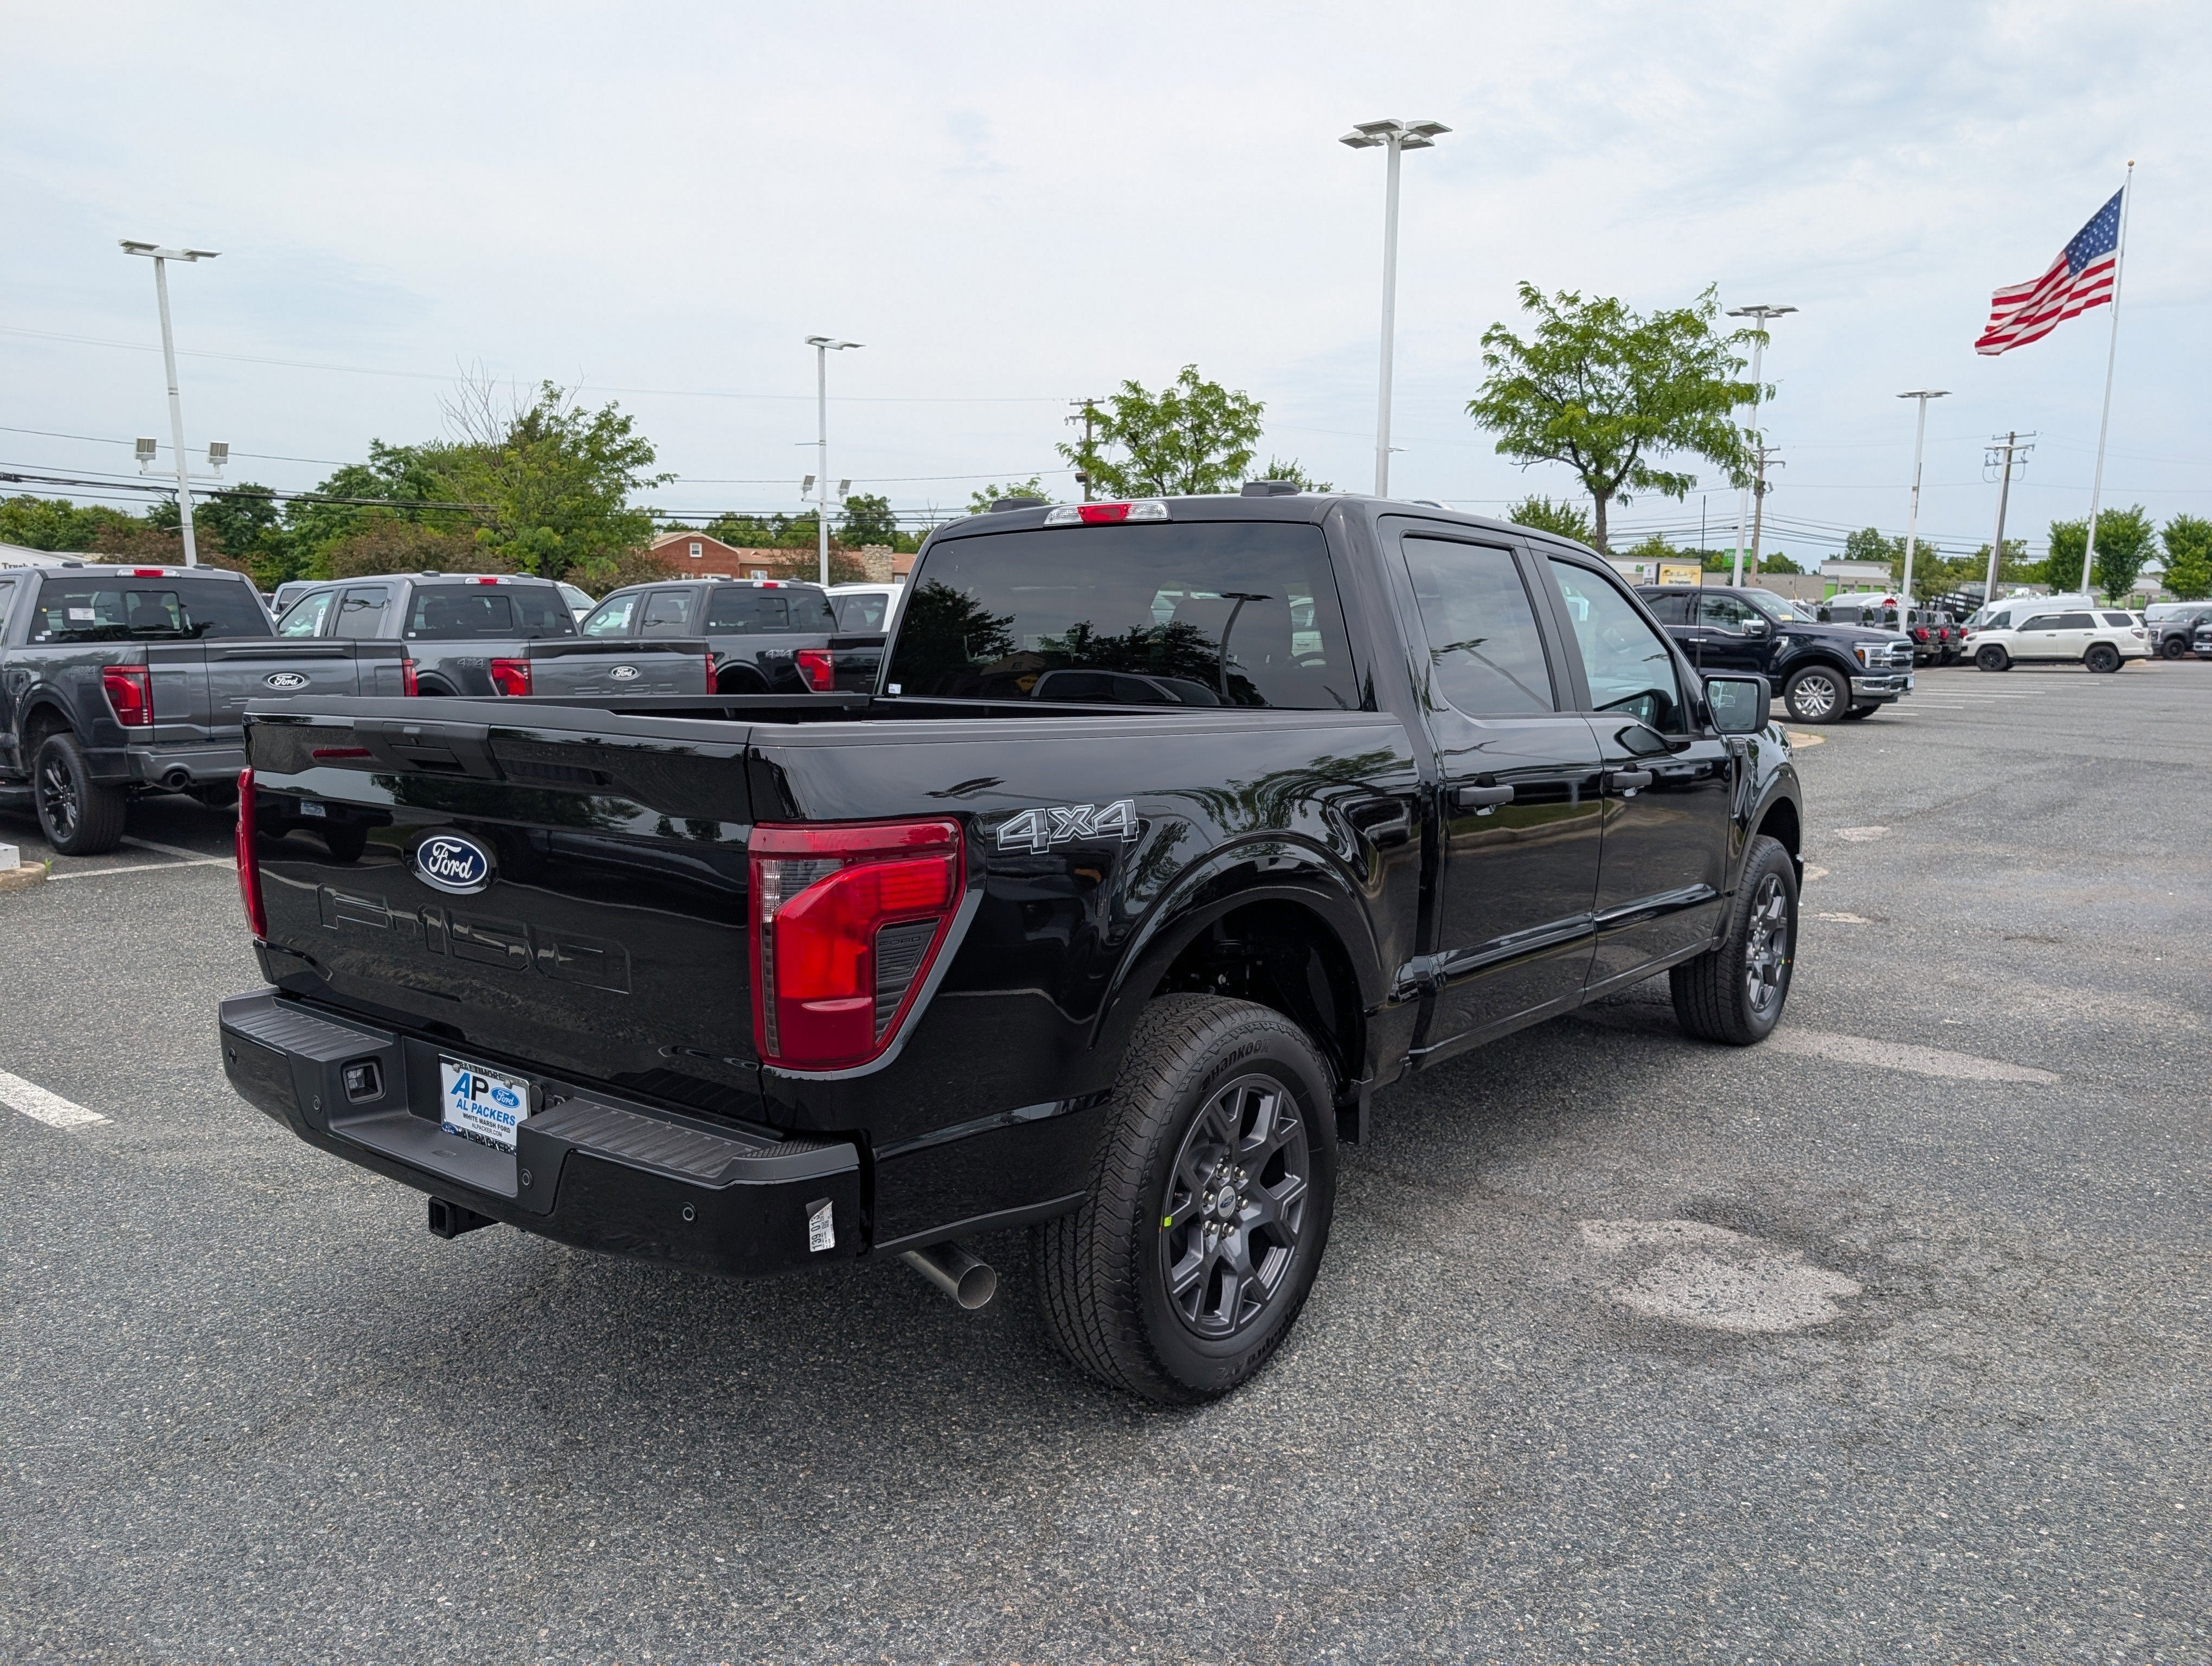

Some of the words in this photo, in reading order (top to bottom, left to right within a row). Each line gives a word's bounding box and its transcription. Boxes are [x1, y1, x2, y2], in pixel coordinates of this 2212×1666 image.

[274, 675, 299, 685] Ford
[616, 668, 633, 677] Ford
[428, 842, 473, 879] Ford
[316, 883, 633, 995] F-150
[878, 935, 921, 947] FORD
[460, 1062, 505, 1081] BALTIMORE
[451, 1072, 489, 1101] AP
[496, 1090, 515, 1106] Ford
[456, 1098, 468, 1111] AL
[471, 1103, 516, 1126] PACKERS
[462, 1112, 478, 1123] WHITE
[479, 1118, 496, 1129] MARSH
[497, 1124, 511, 1133] FORD
[471, 1123, 503, 1137] ALPACKER.COM
[812, 1233, 822, 1250] 139
